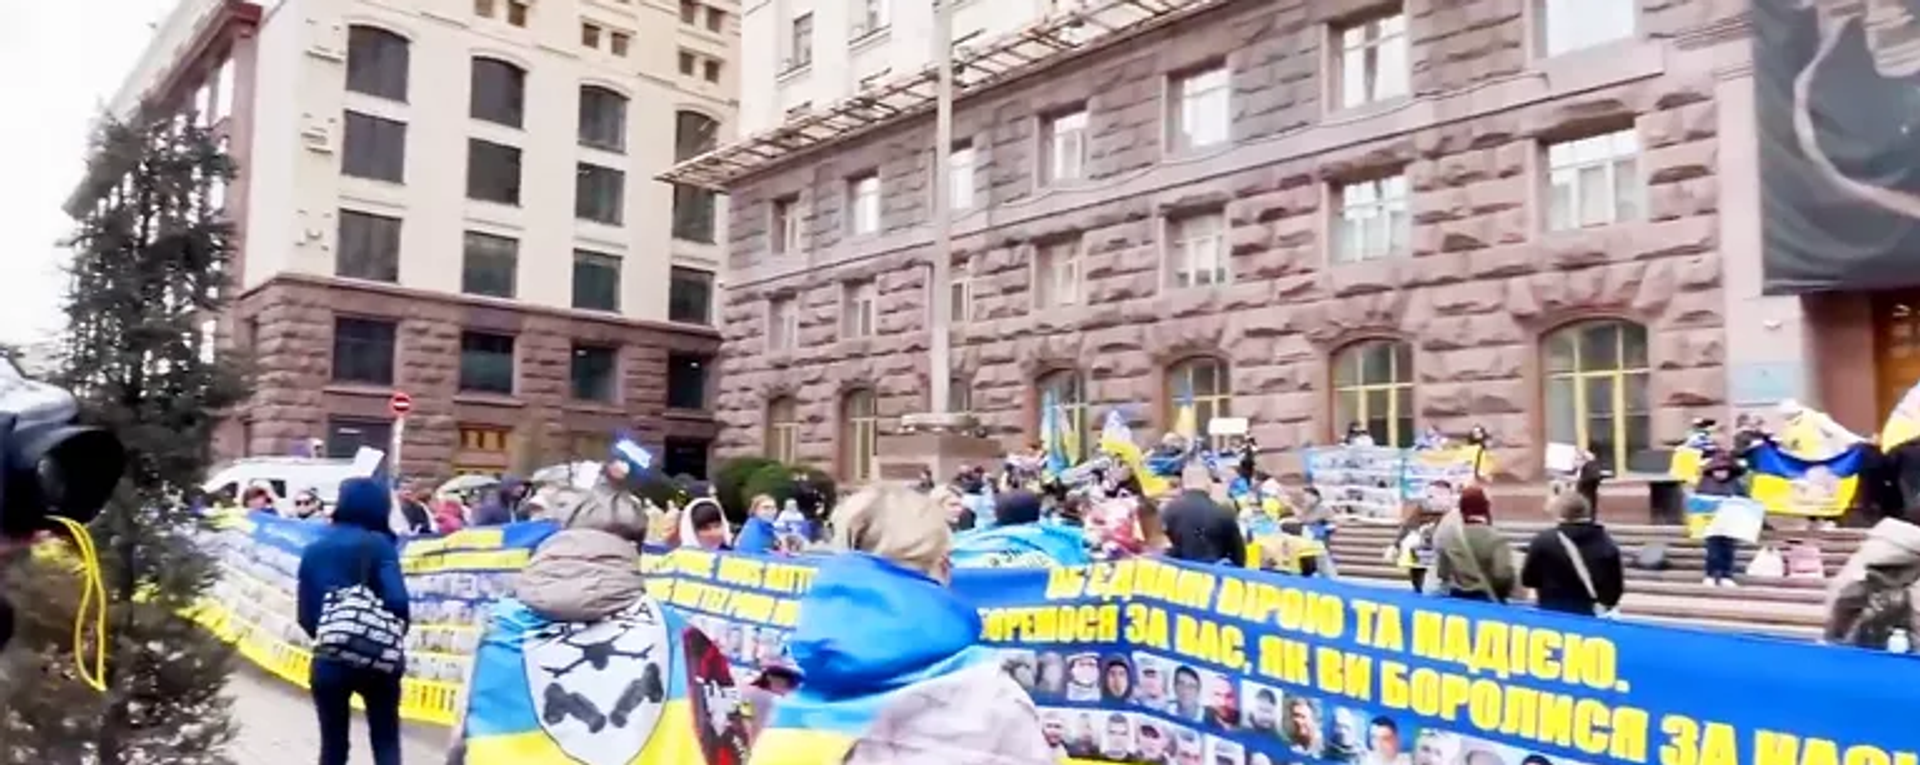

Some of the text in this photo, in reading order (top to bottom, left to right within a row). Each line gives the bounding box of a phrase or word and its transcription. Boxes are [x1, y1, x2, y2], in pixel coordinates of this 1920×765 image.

[1124, 603, 1170, 651] ЗА
[1174, 613, 1252, 674] ВАС,
[1259, 634, 1309, 686] ЯК
[1317, 645, 1372, 701] ВИ
[1380, 660, 1648, 764] БОРОЛИСЯ
[1659, 713, 1738, 765] ЗА
[1217, 576, 1343, 638] ВІРОЮ
[1352, 599, 1404, 651] ТА
[1411, 609, 1630, 692] НАДІЄЮ.
